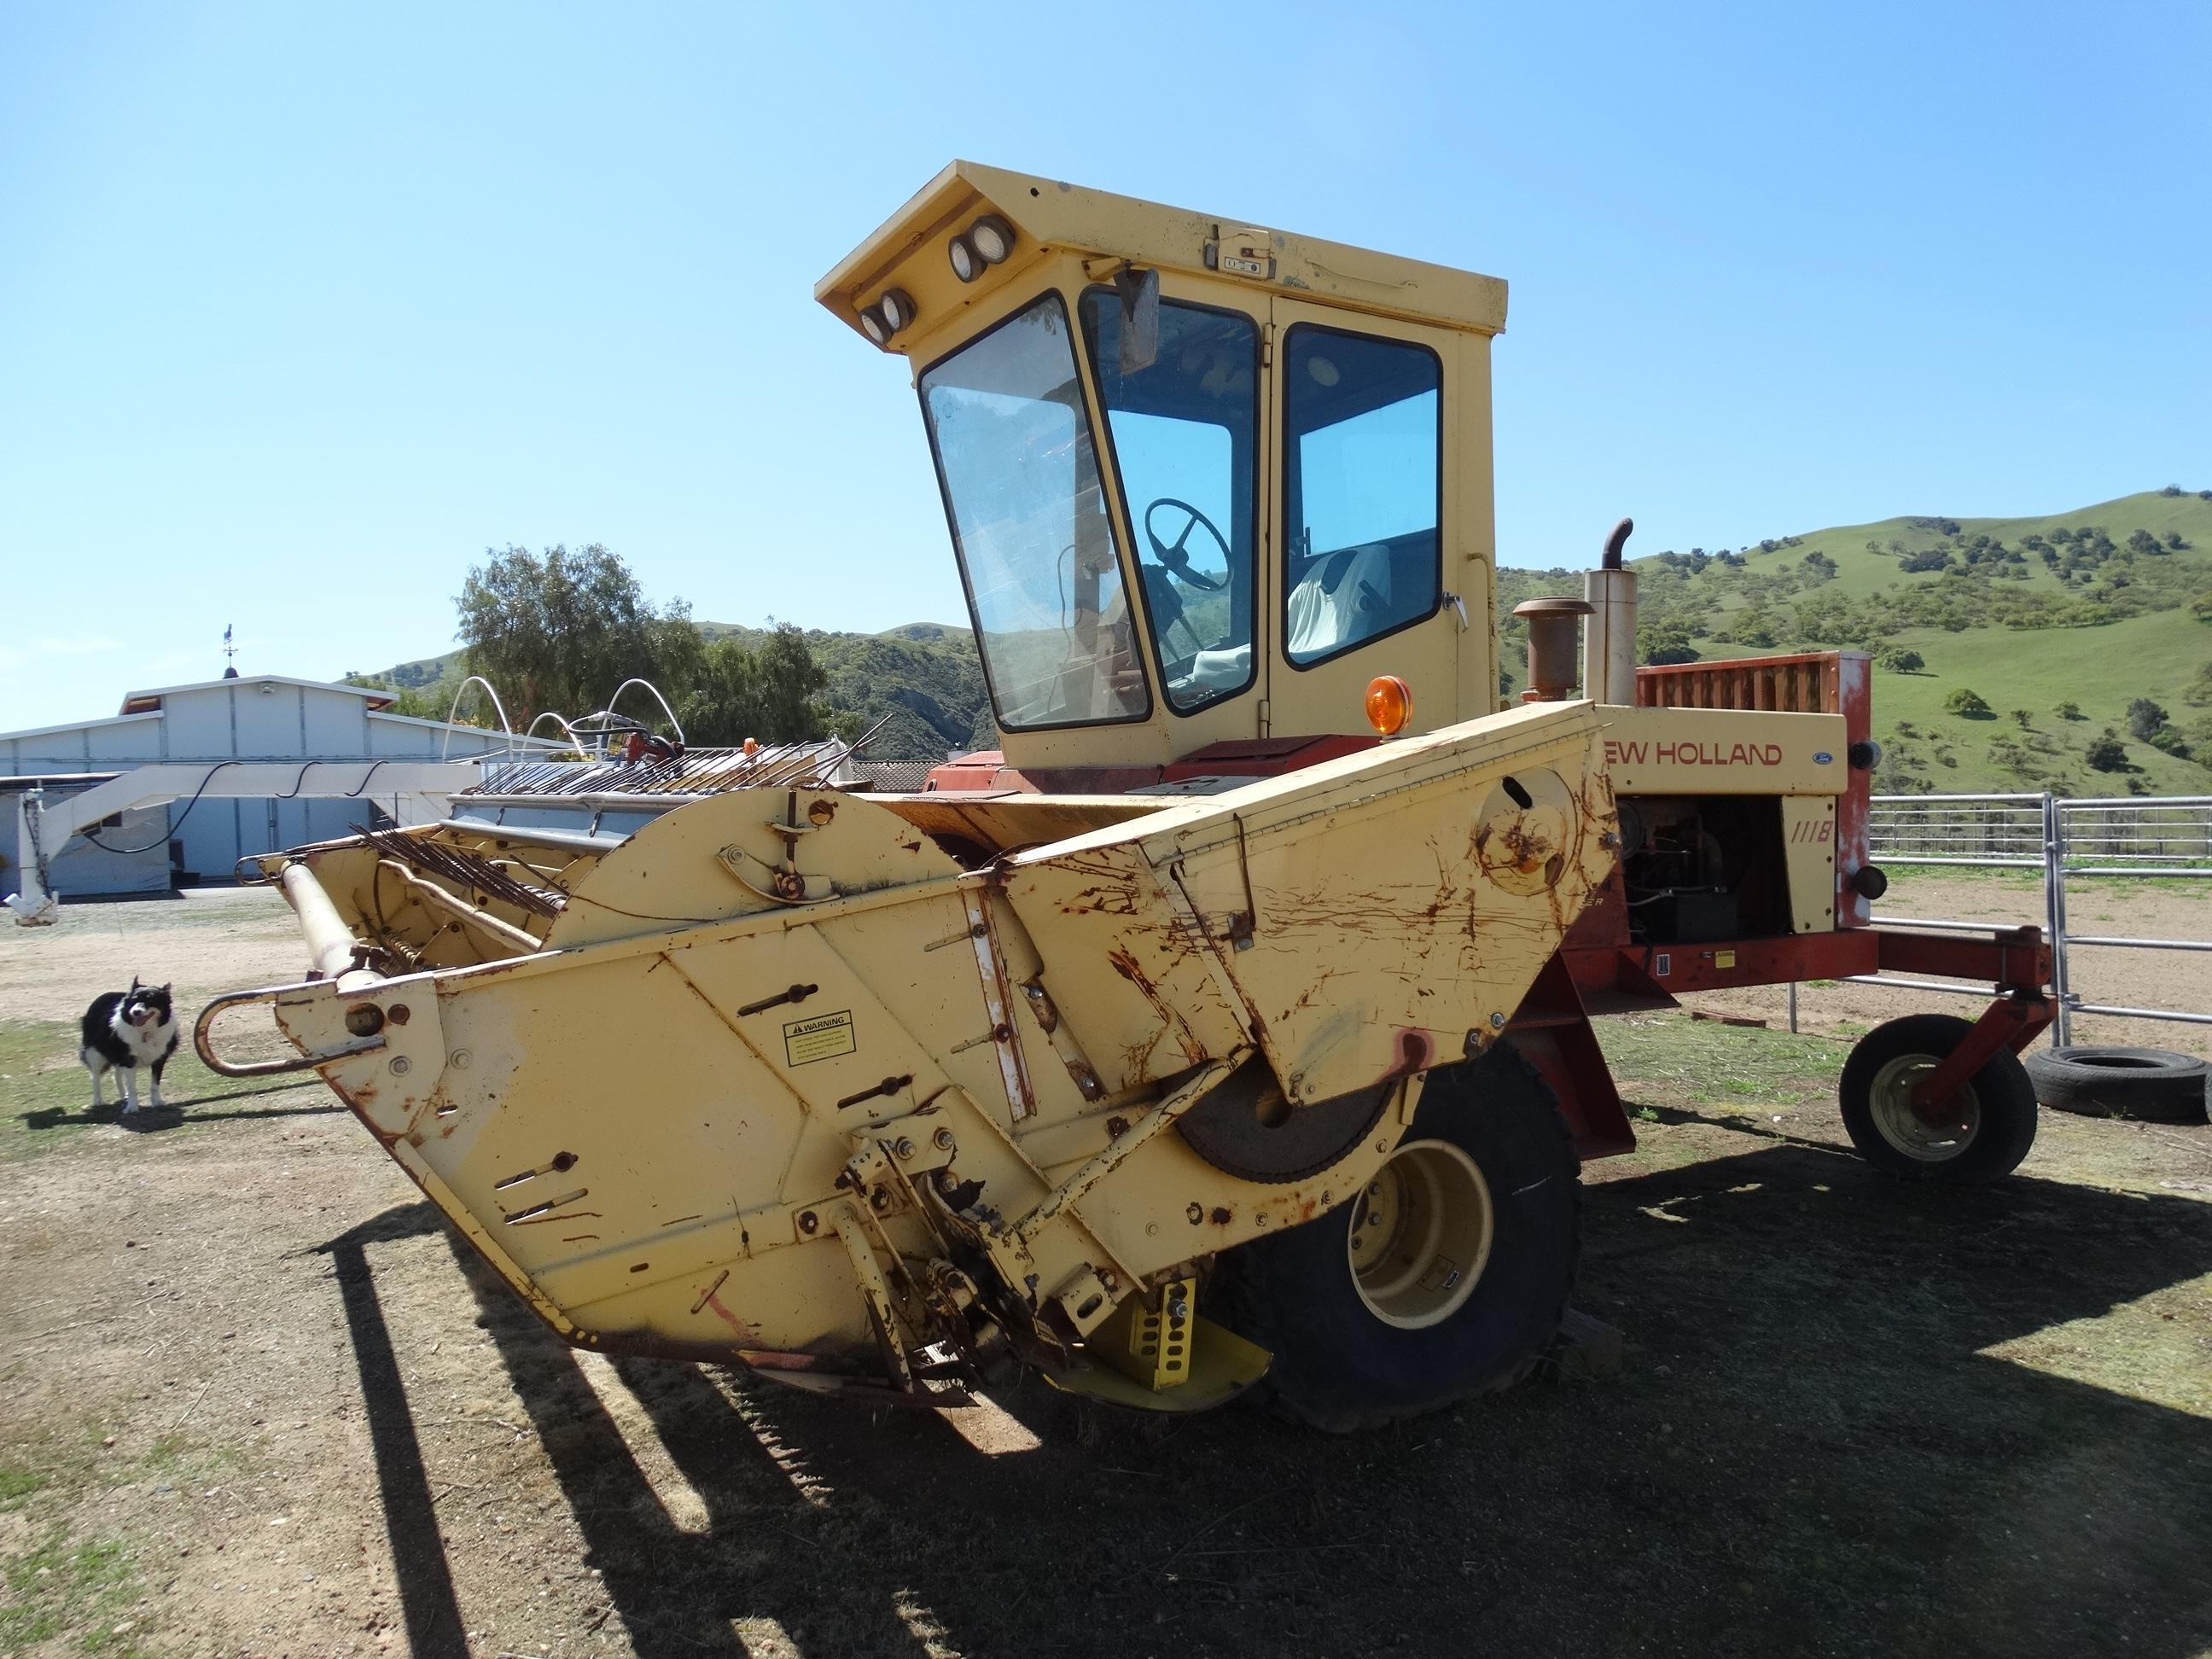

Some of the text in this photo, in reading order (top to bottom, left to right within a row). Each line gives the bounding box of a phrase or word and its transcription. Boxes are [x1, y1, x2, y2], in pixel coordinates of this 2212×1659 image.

[1604, 741, 1783, 765] EW HOLLAND
[1791, 820, 1834, 843] 1118
[803, 1016, 845, 1032] WARNING
